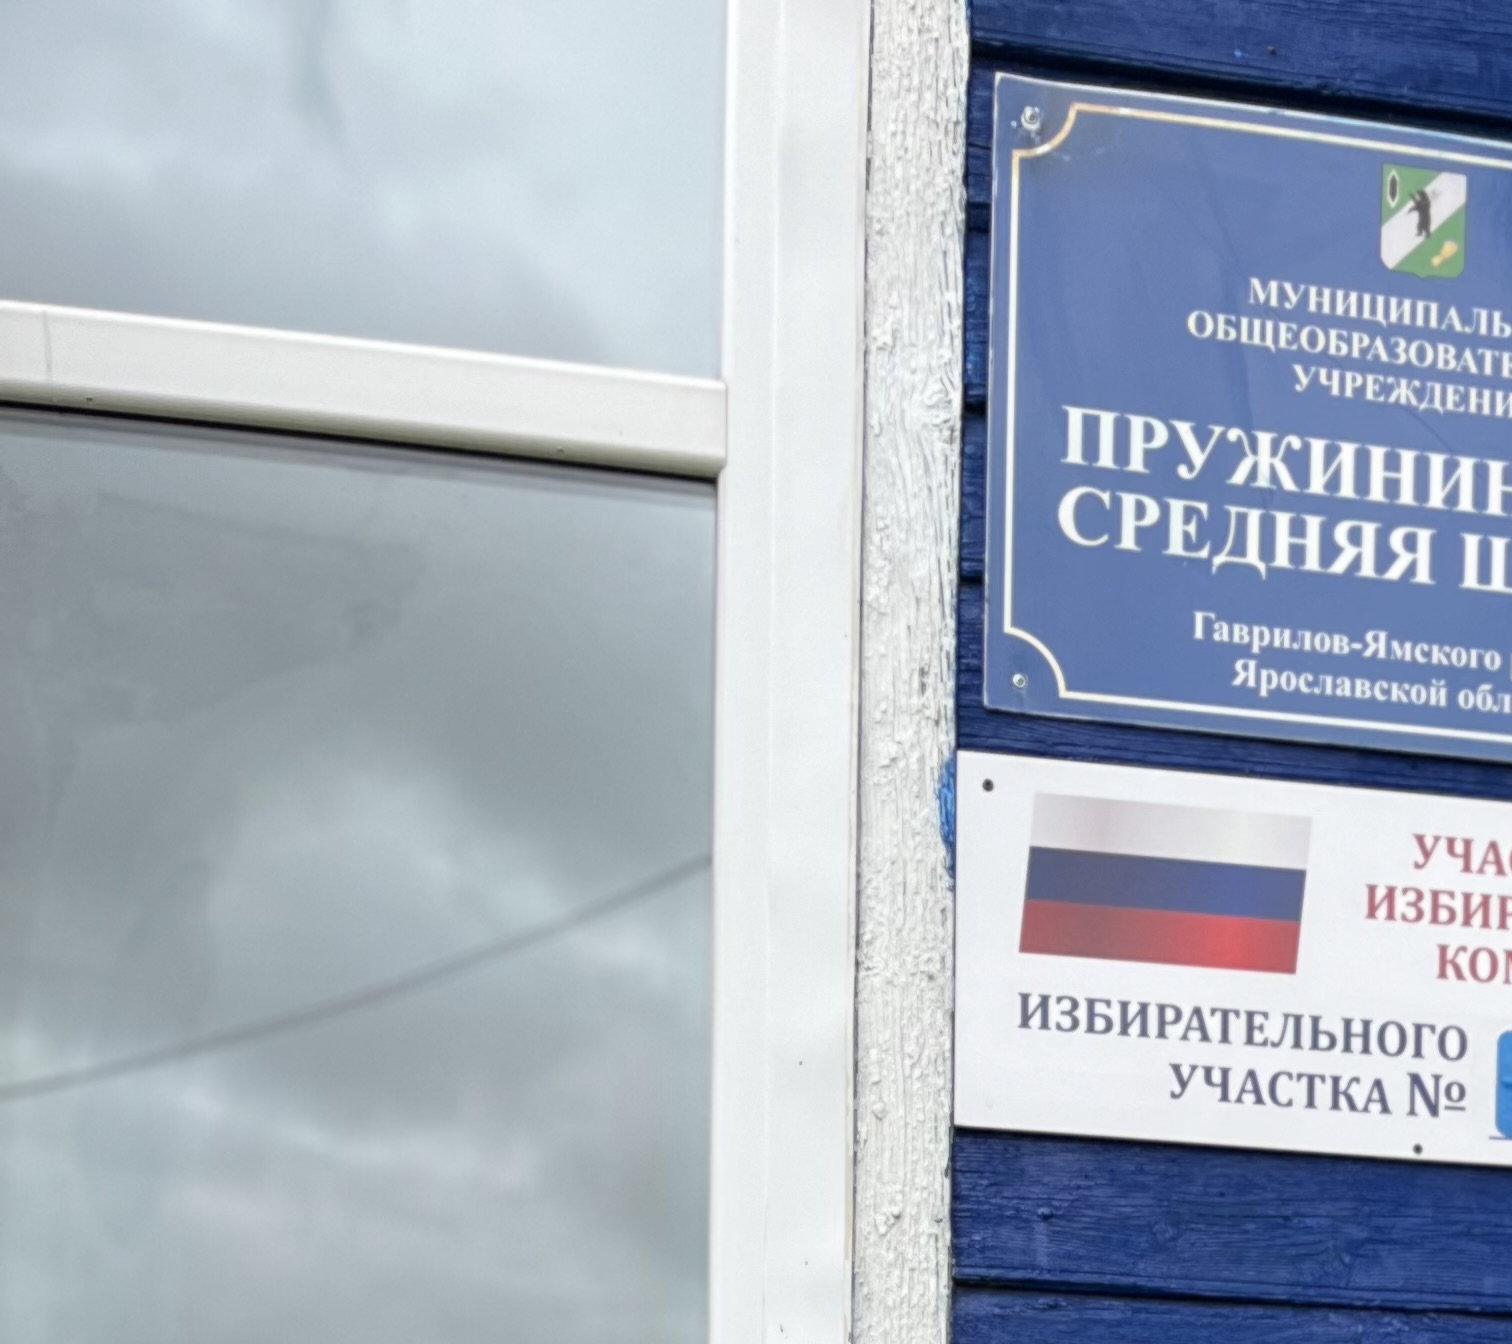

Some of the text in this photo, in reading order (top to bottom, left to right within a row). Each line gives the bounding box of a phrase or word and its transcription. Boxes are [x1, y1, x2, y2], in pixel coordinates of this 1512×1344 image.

[1057, 486, 1436, 586] СРЕДНЯЯ
[1191, 610, 1502, 673] Гаврилов-Ямского
[1231, 658, 1448, 711] Ярославской
[1017, 992, 1468, 1063] ИЗБИРАТЕЛЬНОГО
[1169, 1062, 1393, 1116] УЧАСТКА
[1406, 1074, 1467, 1118] №
